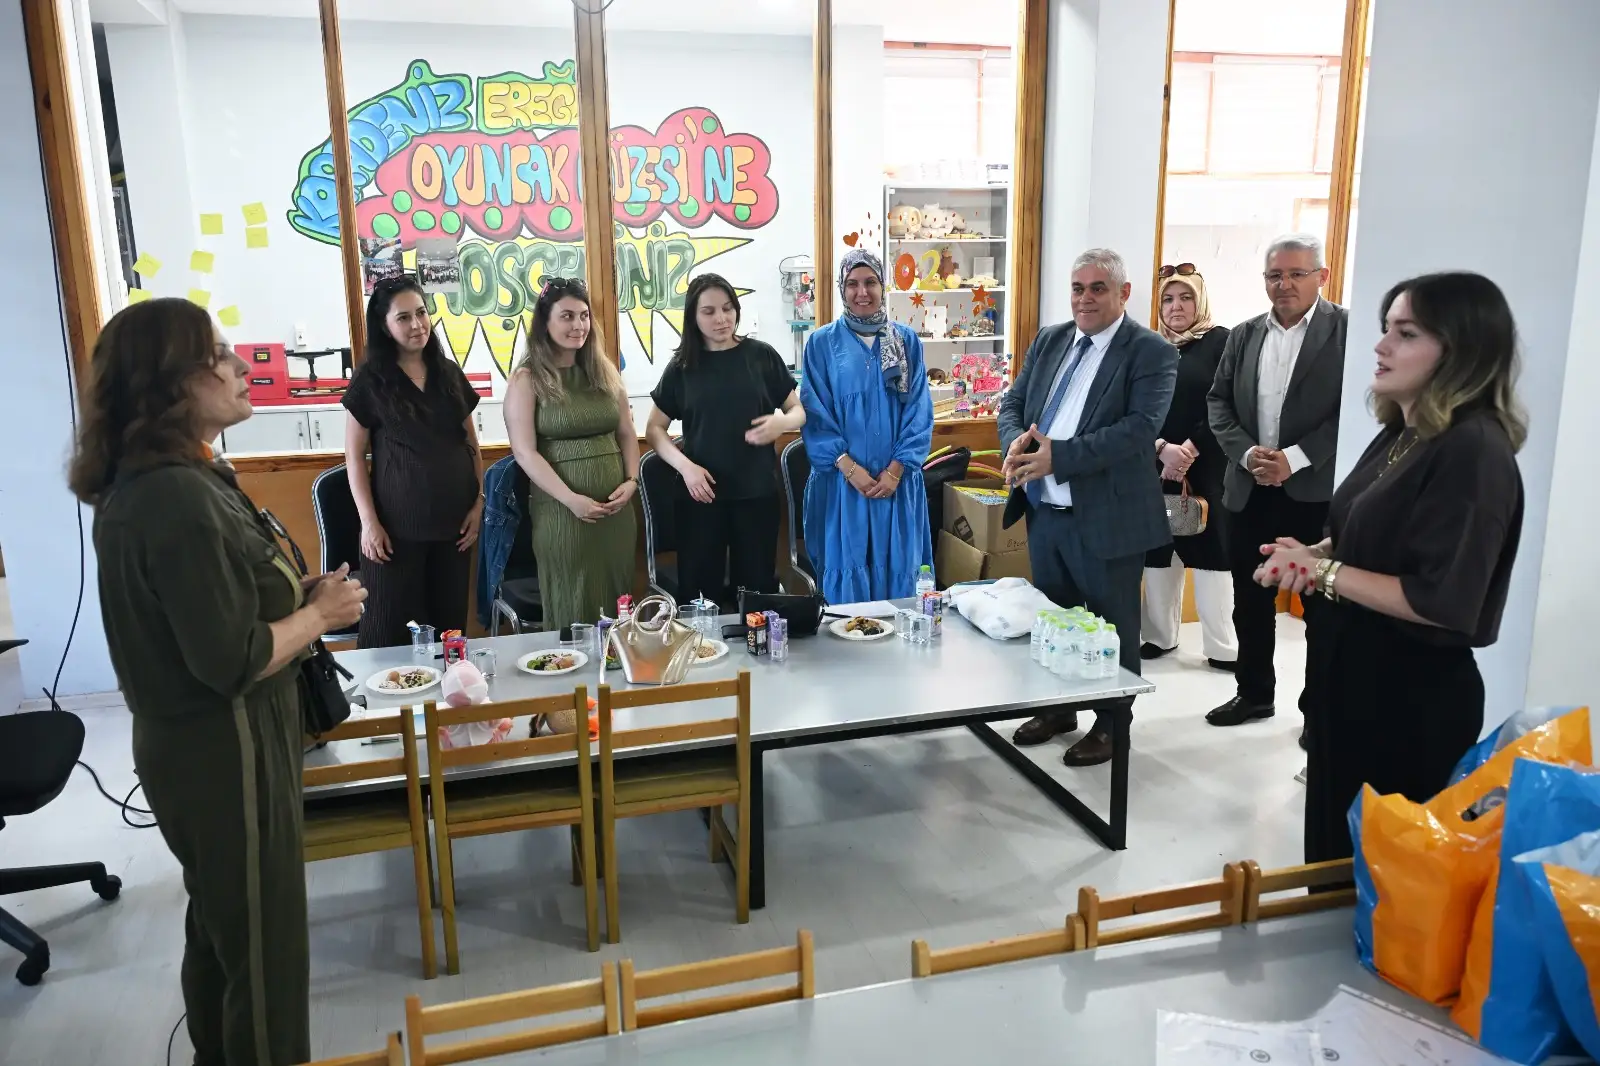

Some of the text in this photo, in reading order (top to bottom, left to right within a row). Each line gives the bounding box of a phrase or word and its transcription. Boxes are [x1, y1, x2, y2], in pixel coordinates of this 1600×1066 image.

[482, 66, 579, 130] EREĞ
[411, 115, 758, 208] OYUNCAK ÜZESİ'NE
